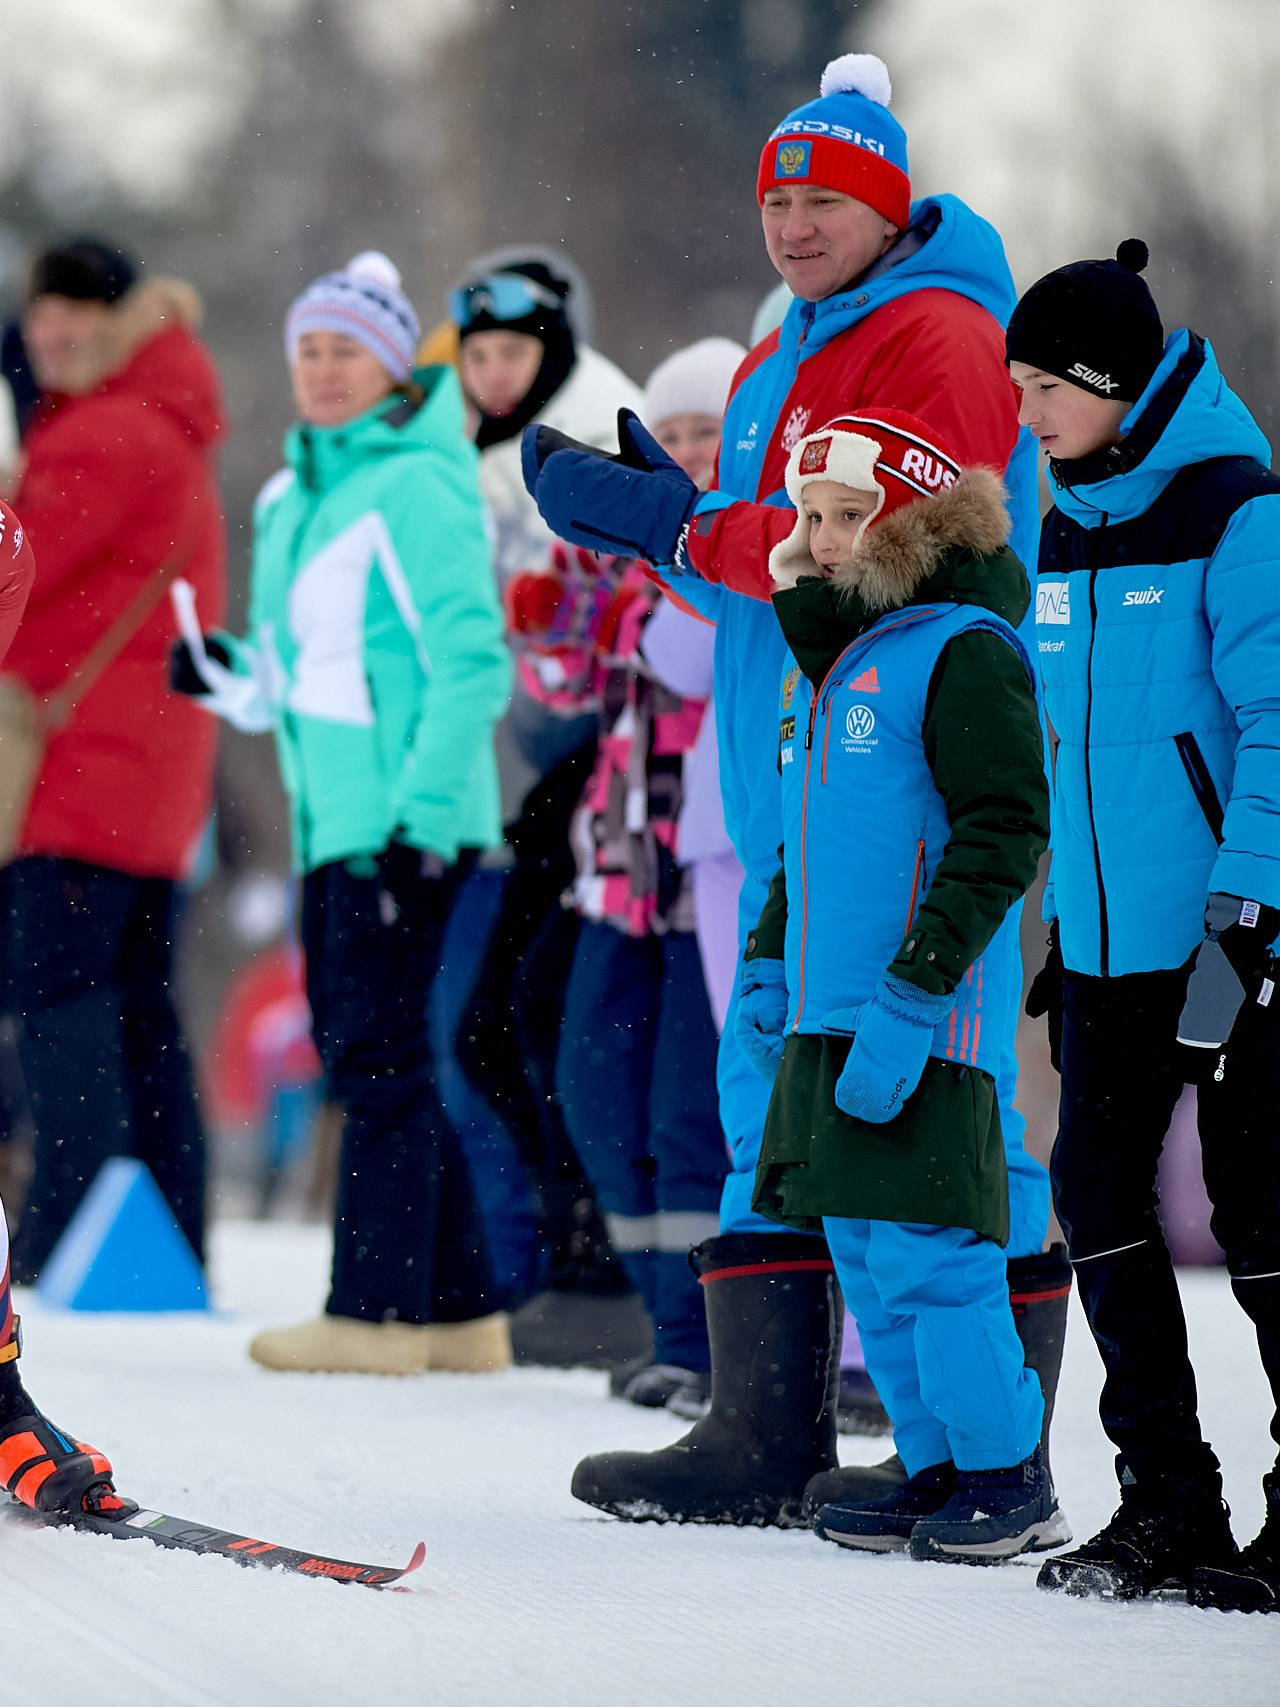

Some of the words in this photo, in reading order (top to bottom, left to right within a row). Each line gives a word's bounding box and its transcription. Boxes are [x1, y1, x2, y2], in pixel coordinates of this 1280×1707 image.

[771, 120, 885, 157] RDSKI
[840, 737, 879, 746] Commercial
[845, 746, 872, 754] Vehicles
